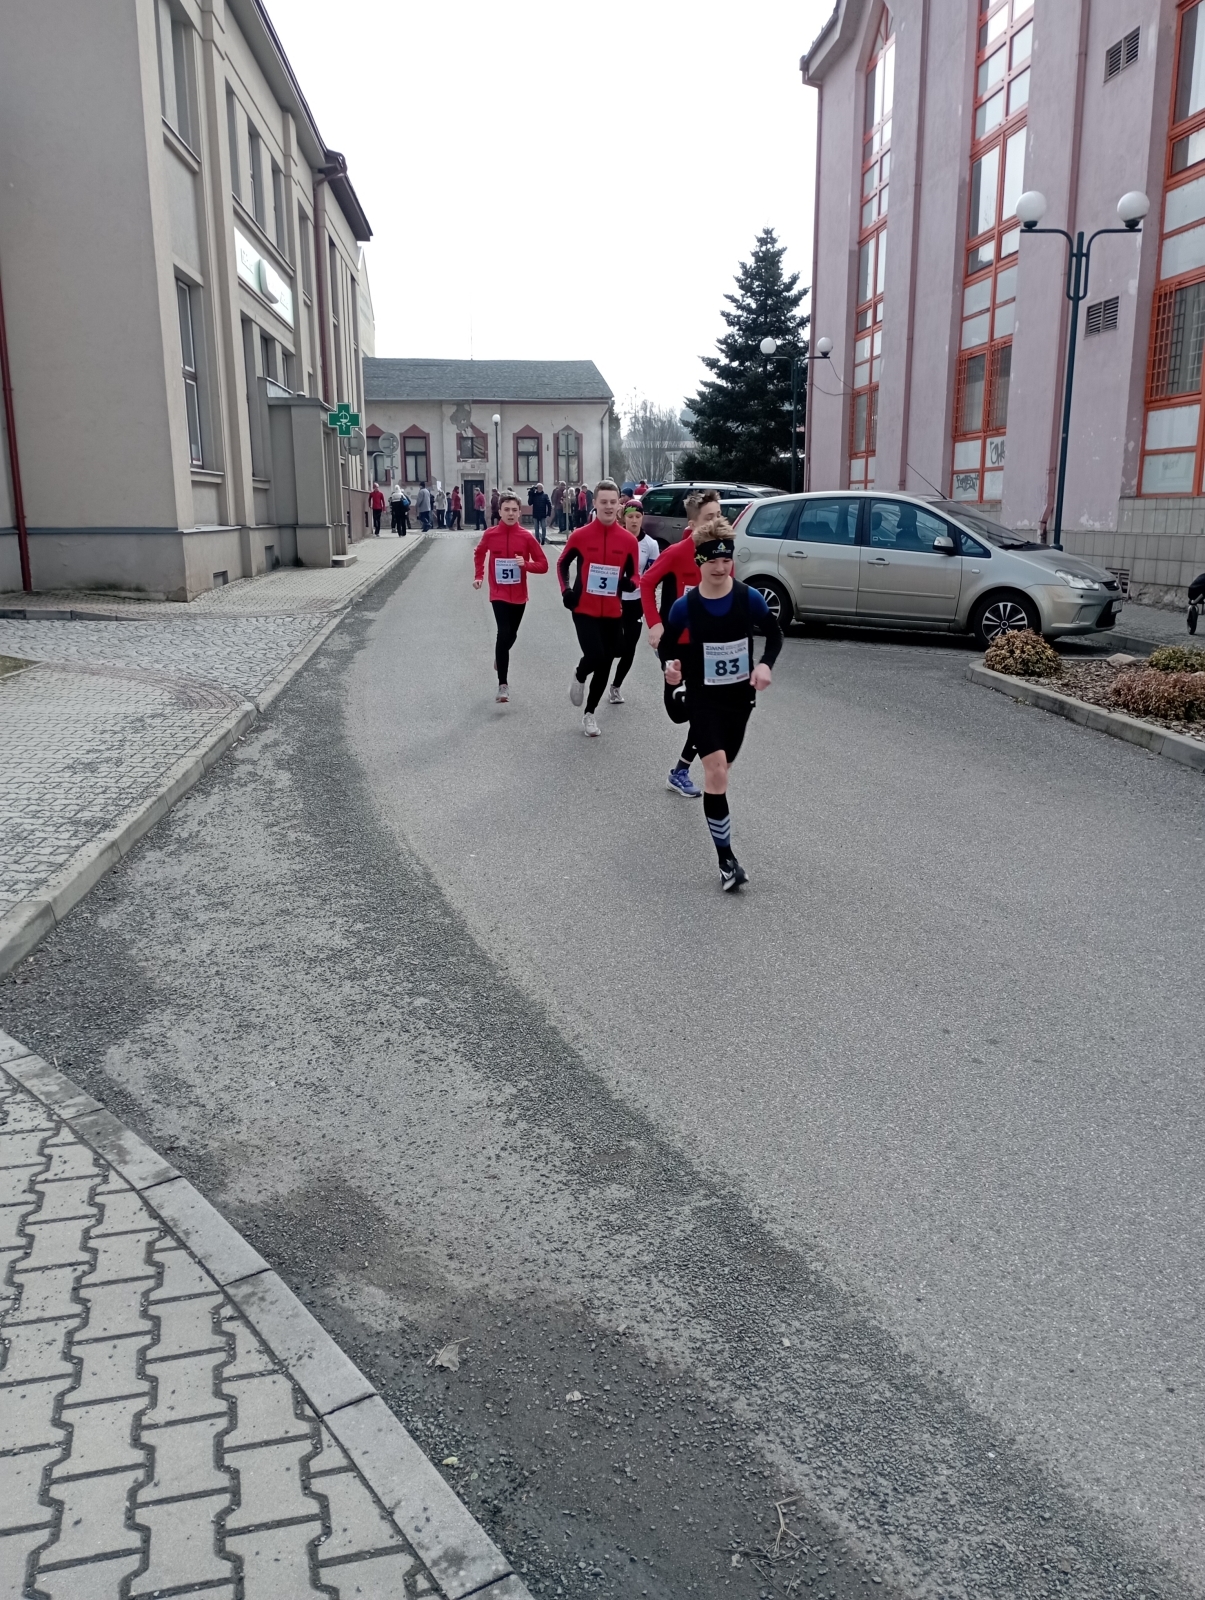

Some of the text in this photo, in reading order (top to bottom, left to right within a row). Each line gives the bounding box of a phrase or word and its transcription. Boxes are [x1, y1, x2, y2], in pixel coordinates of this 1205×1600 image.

[502, 569, 514, 579] 51
[599, 577, 608, 589] 3
[715, 658, 740, 677] 83
